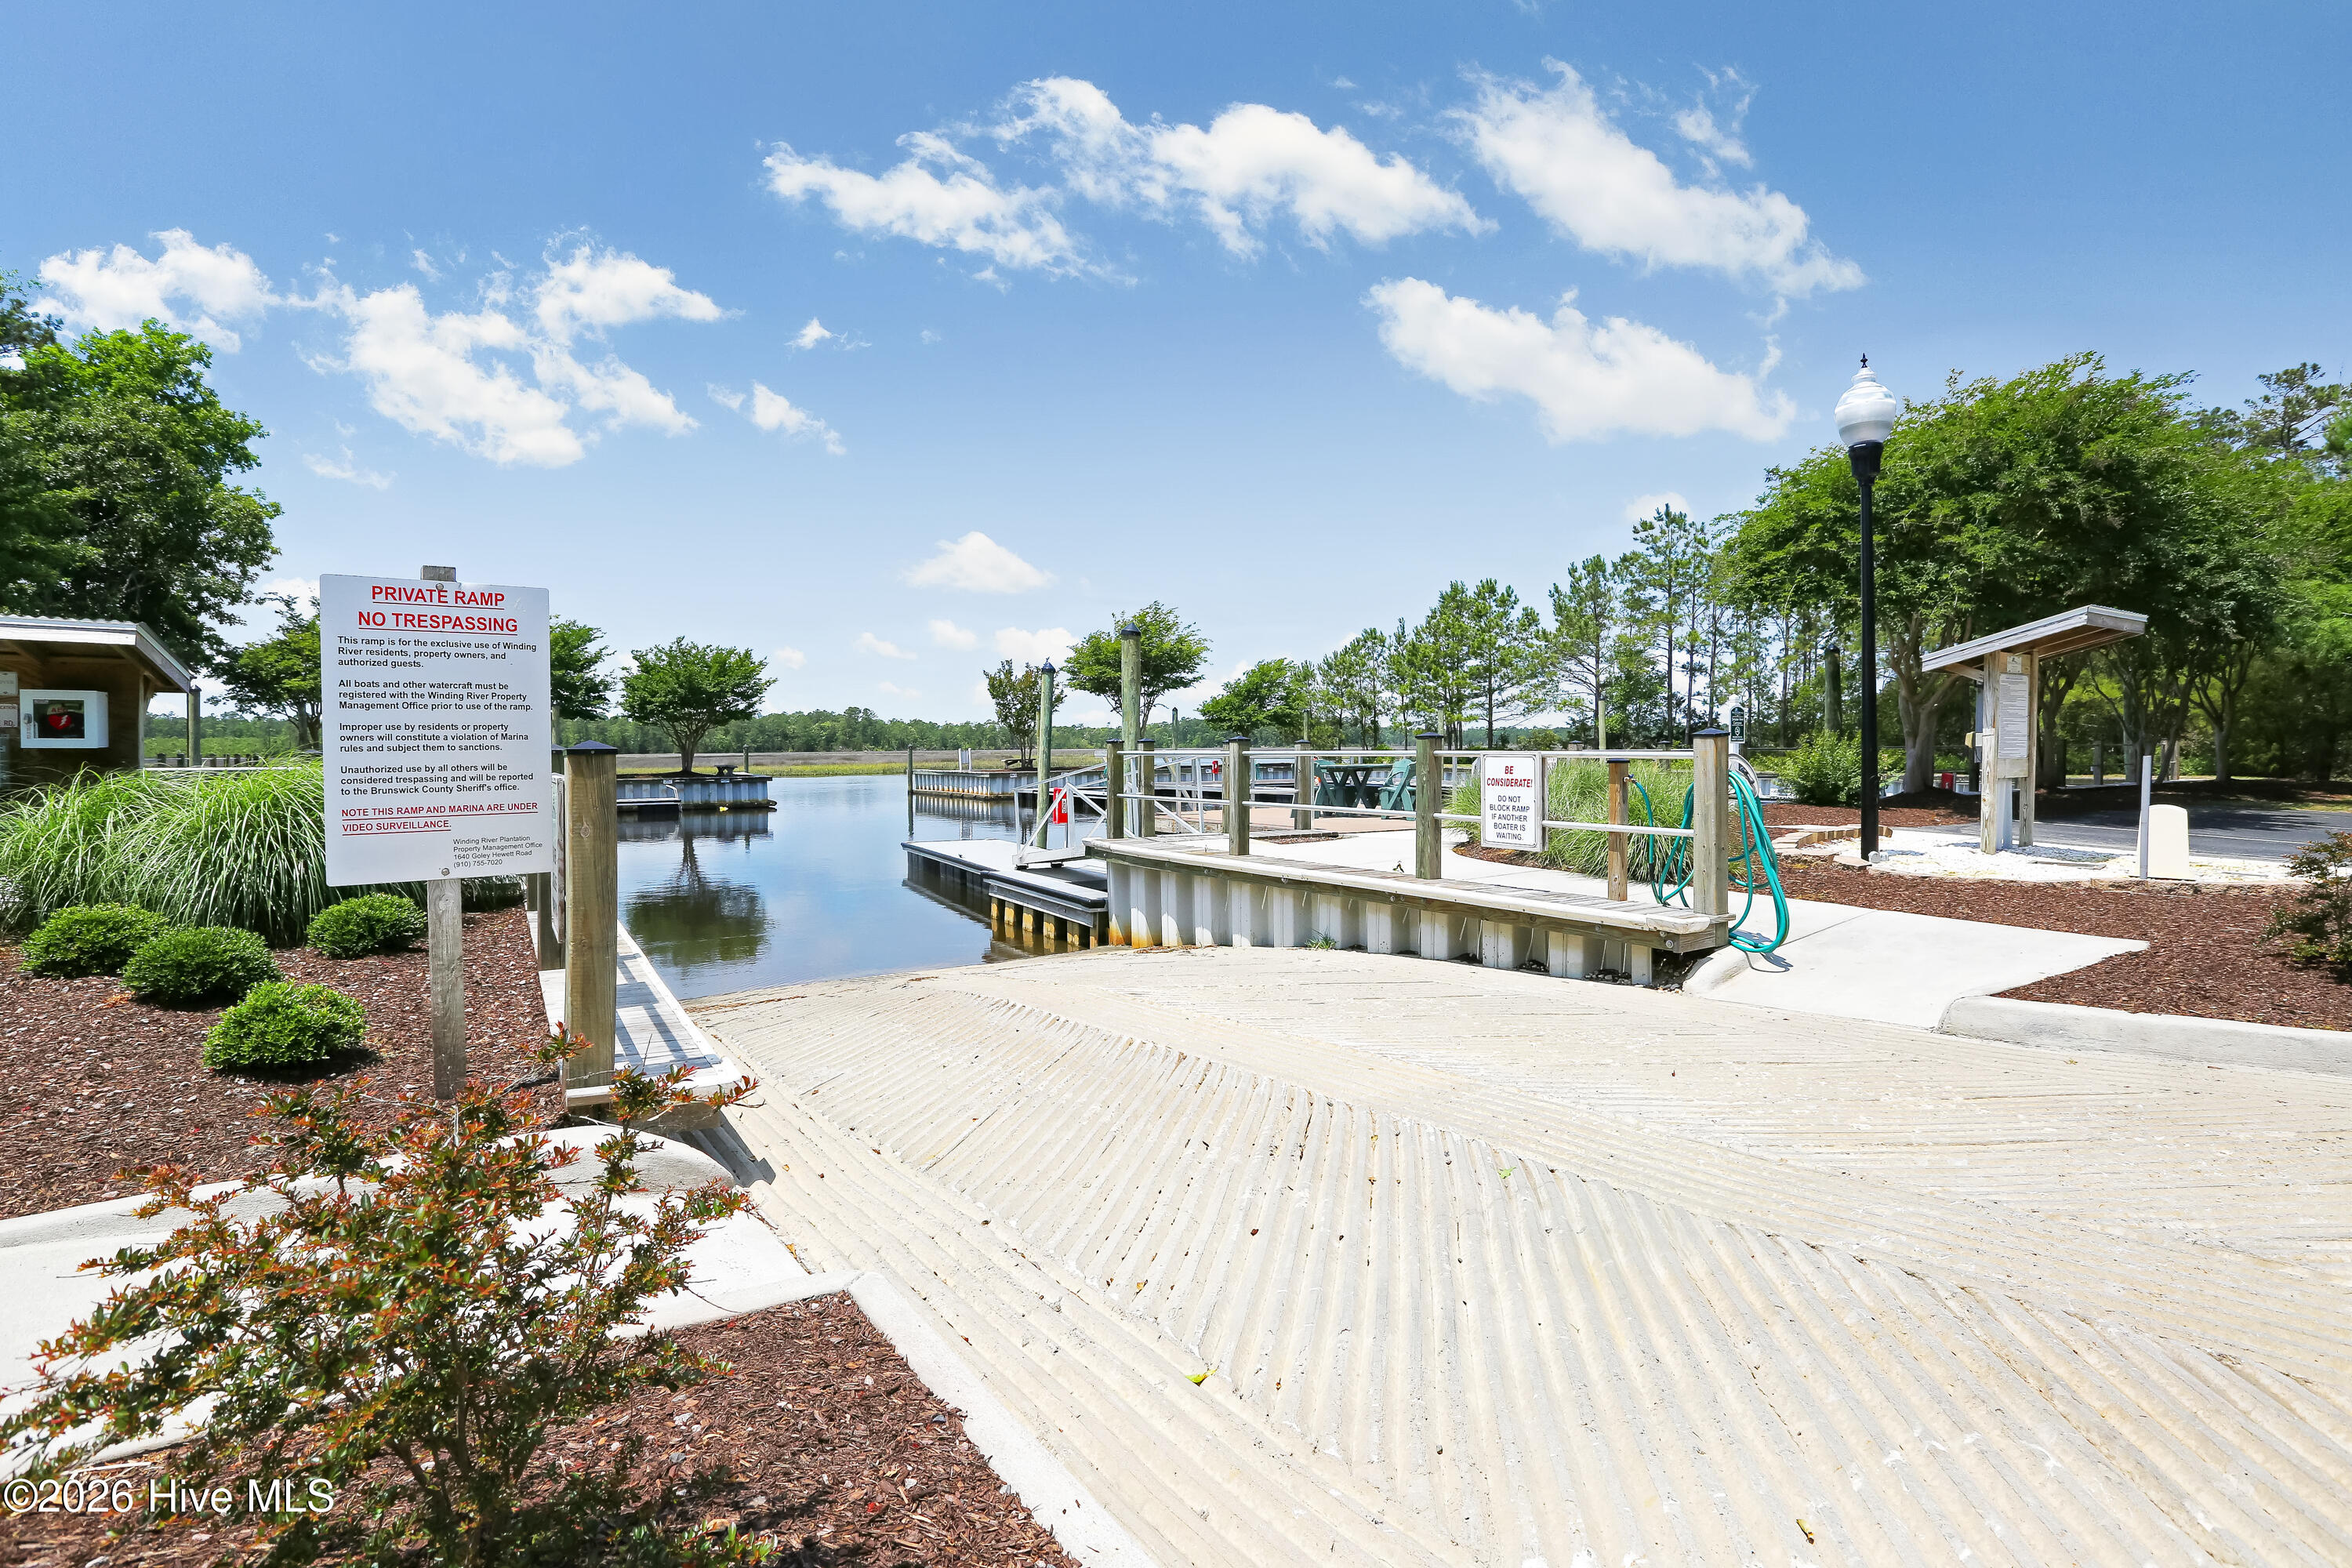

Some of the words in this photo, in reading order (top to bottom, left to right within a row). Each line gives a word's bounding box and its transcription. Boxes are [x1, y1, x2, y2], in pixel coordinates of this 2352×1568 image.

[372, 586, 448, 604] PRIVATE
[455, 590, 505, 607] RAMP
[358, 612, 386, 626] NO
[392, 613, 517, 632] TRESPASSING
[337, 636, 358, 644] This
[361, 638, 384, 648] ramp
[431, 639, 472, 648] exclusive
[503, 641, 536, 652] Winding
[338, 647, 362, 655] River
[365, 648, 411, 658] residents,
[414, 649, 452, 659] property
[454, 651, 488, 659] owners,
[391, 659, 423, 668] guests.
[339, 680, 351, 688] All
[354, 680, 379, 688] boats
[339, 691, 386, 700] registered
[428, 691, 464, 701] Winding
[491, 693, 527, 702] Property
[339, 702, 398, 710] Management
[401, 702, 428, 710] Office
[431, 702, 452, 711] prior
[510, 703, 533, 712] ramp.
[339, 723, 383, 732] Improper
[405, 723, 416, 732] by
[473, 723, 508, 732] property
[377, 733, 392, 742] will
[395, 733, 441, 742] constitute
[340, 743, 364, 753] rules
[387, 743, 420, 753] subject
[425, 765, 435, 774] by
[1505, 766, 1514, 775] BE
[395, 775, 448, 786] trespassing
[499, 773, 533, 782] reported
[1486, 778, 1533, 787] CONSIDERATE!
[371, 786, 419, 794] Brunswick
[422, 784, 453, 794] County
[456, 783, 491, 792] Sheriff's
[494, 782, 519, 791] office.
[342, 808, 368, 817] NOTE
[372, 808, 394, 816] THIS
[397, 806, 424, 815] RAMP
[448, 804, 485, 813] MARINA
[342, 823, 373, 833] VIDEO
[376, 820, 452, 831] SURVEILLANCE.
[483, 843, 524, 851] Management
[453, 859, 470, 868] (910)
[473, 858, 502, 867] 755-7020
